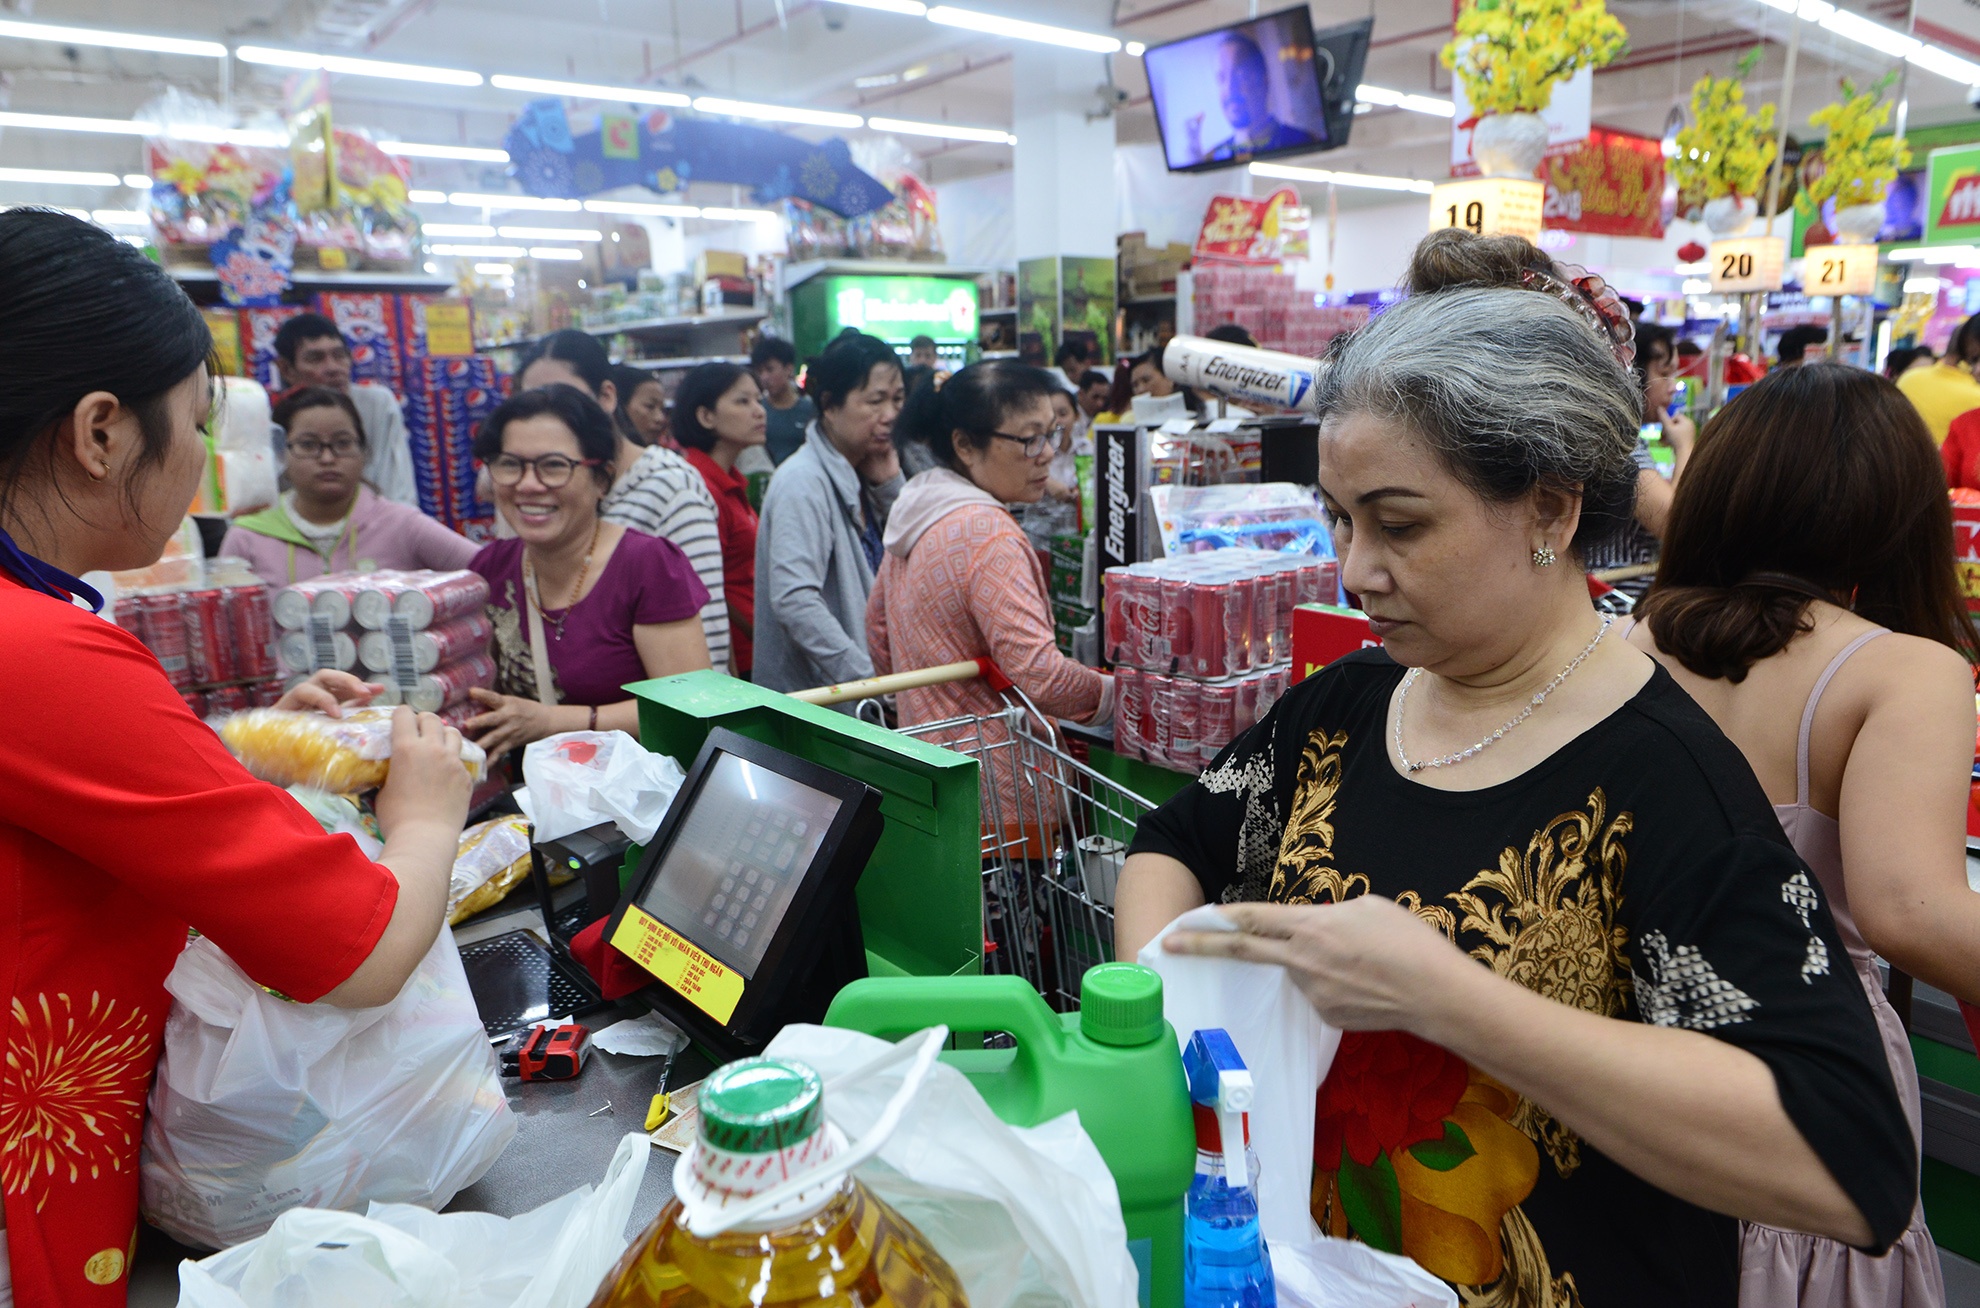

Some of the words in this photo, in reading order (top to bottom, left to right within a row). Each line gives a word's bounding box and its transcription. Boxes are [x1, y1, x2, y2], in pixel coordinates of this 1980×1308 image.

[1446, 201, 1483, 234] 19
[1721, 253, 1752, 279] 20
[1821, 259, 1845, 284] 21
[1204, 355, 1288, 391] Energizer
[1104, 434, 1129, 564] Energizer
[700, 958, 710, 968] THU
